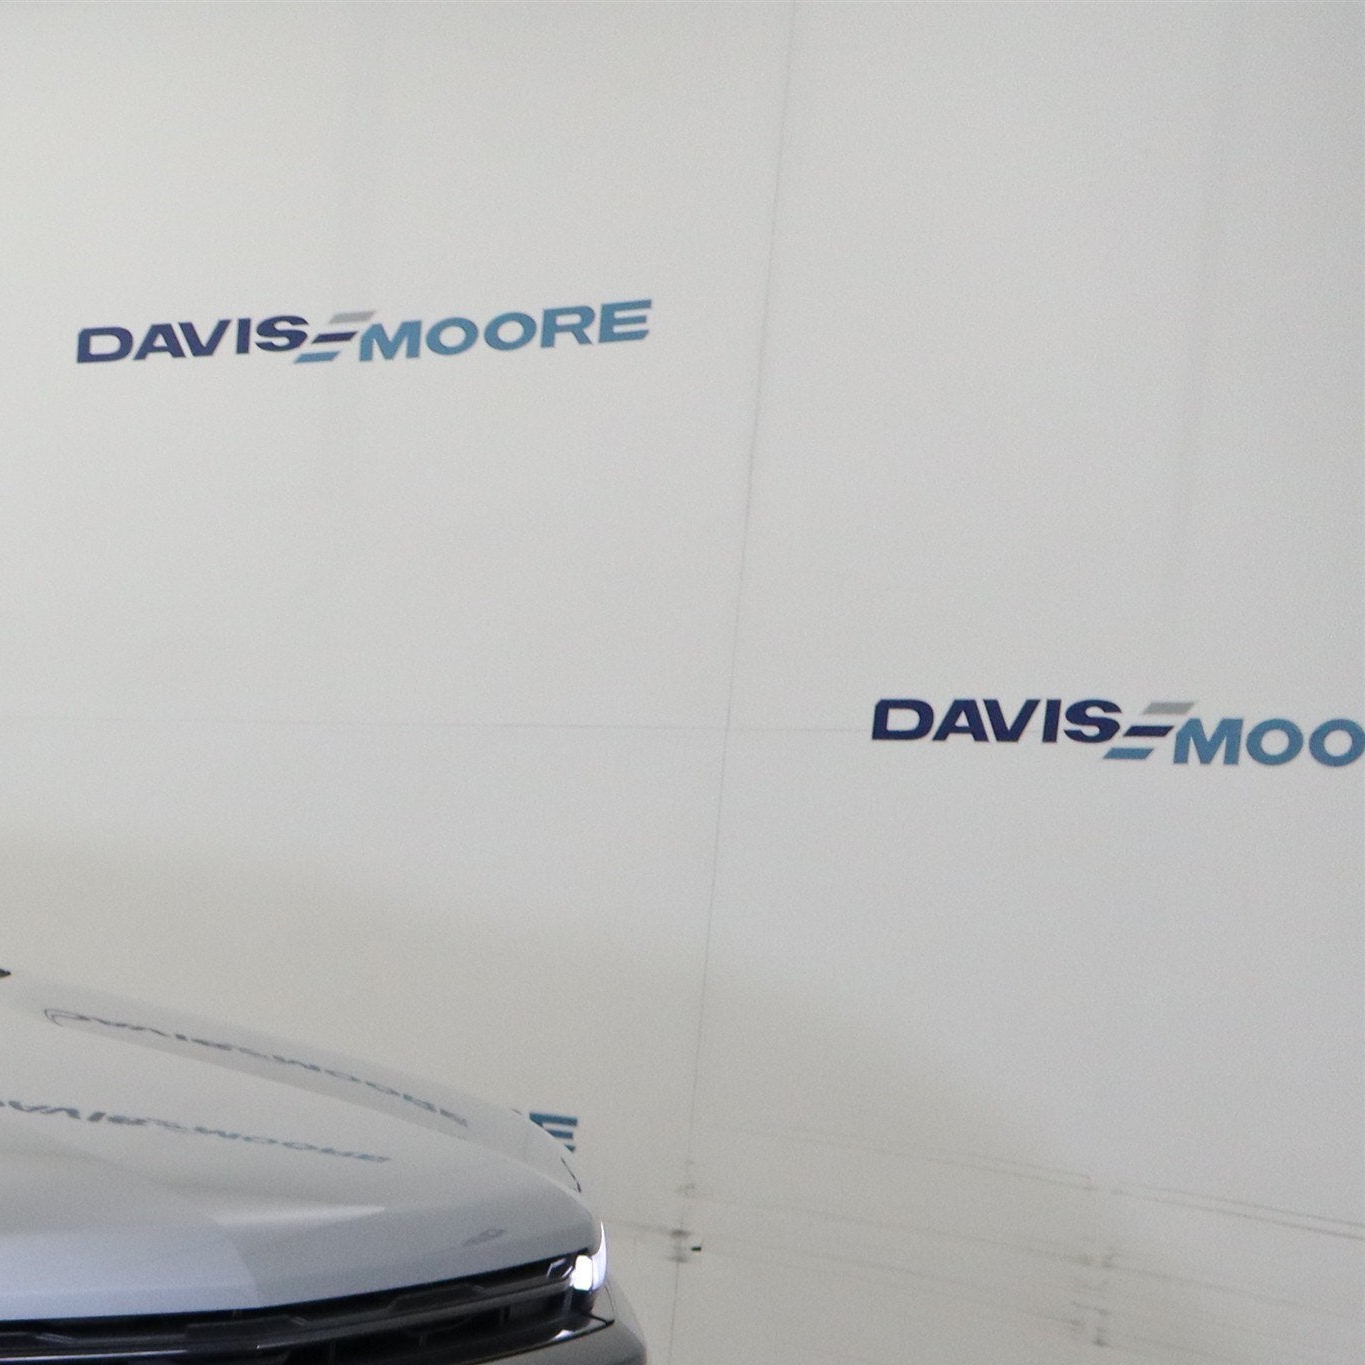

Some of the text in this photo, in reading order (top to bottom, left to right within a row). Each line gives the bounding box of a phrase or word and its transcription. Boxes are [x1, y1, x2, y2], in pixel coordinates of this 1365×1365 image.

[75, 298, 653, 365] DAVIS MOORE
[870, 697, 1365, 768] DAVIS MOO
